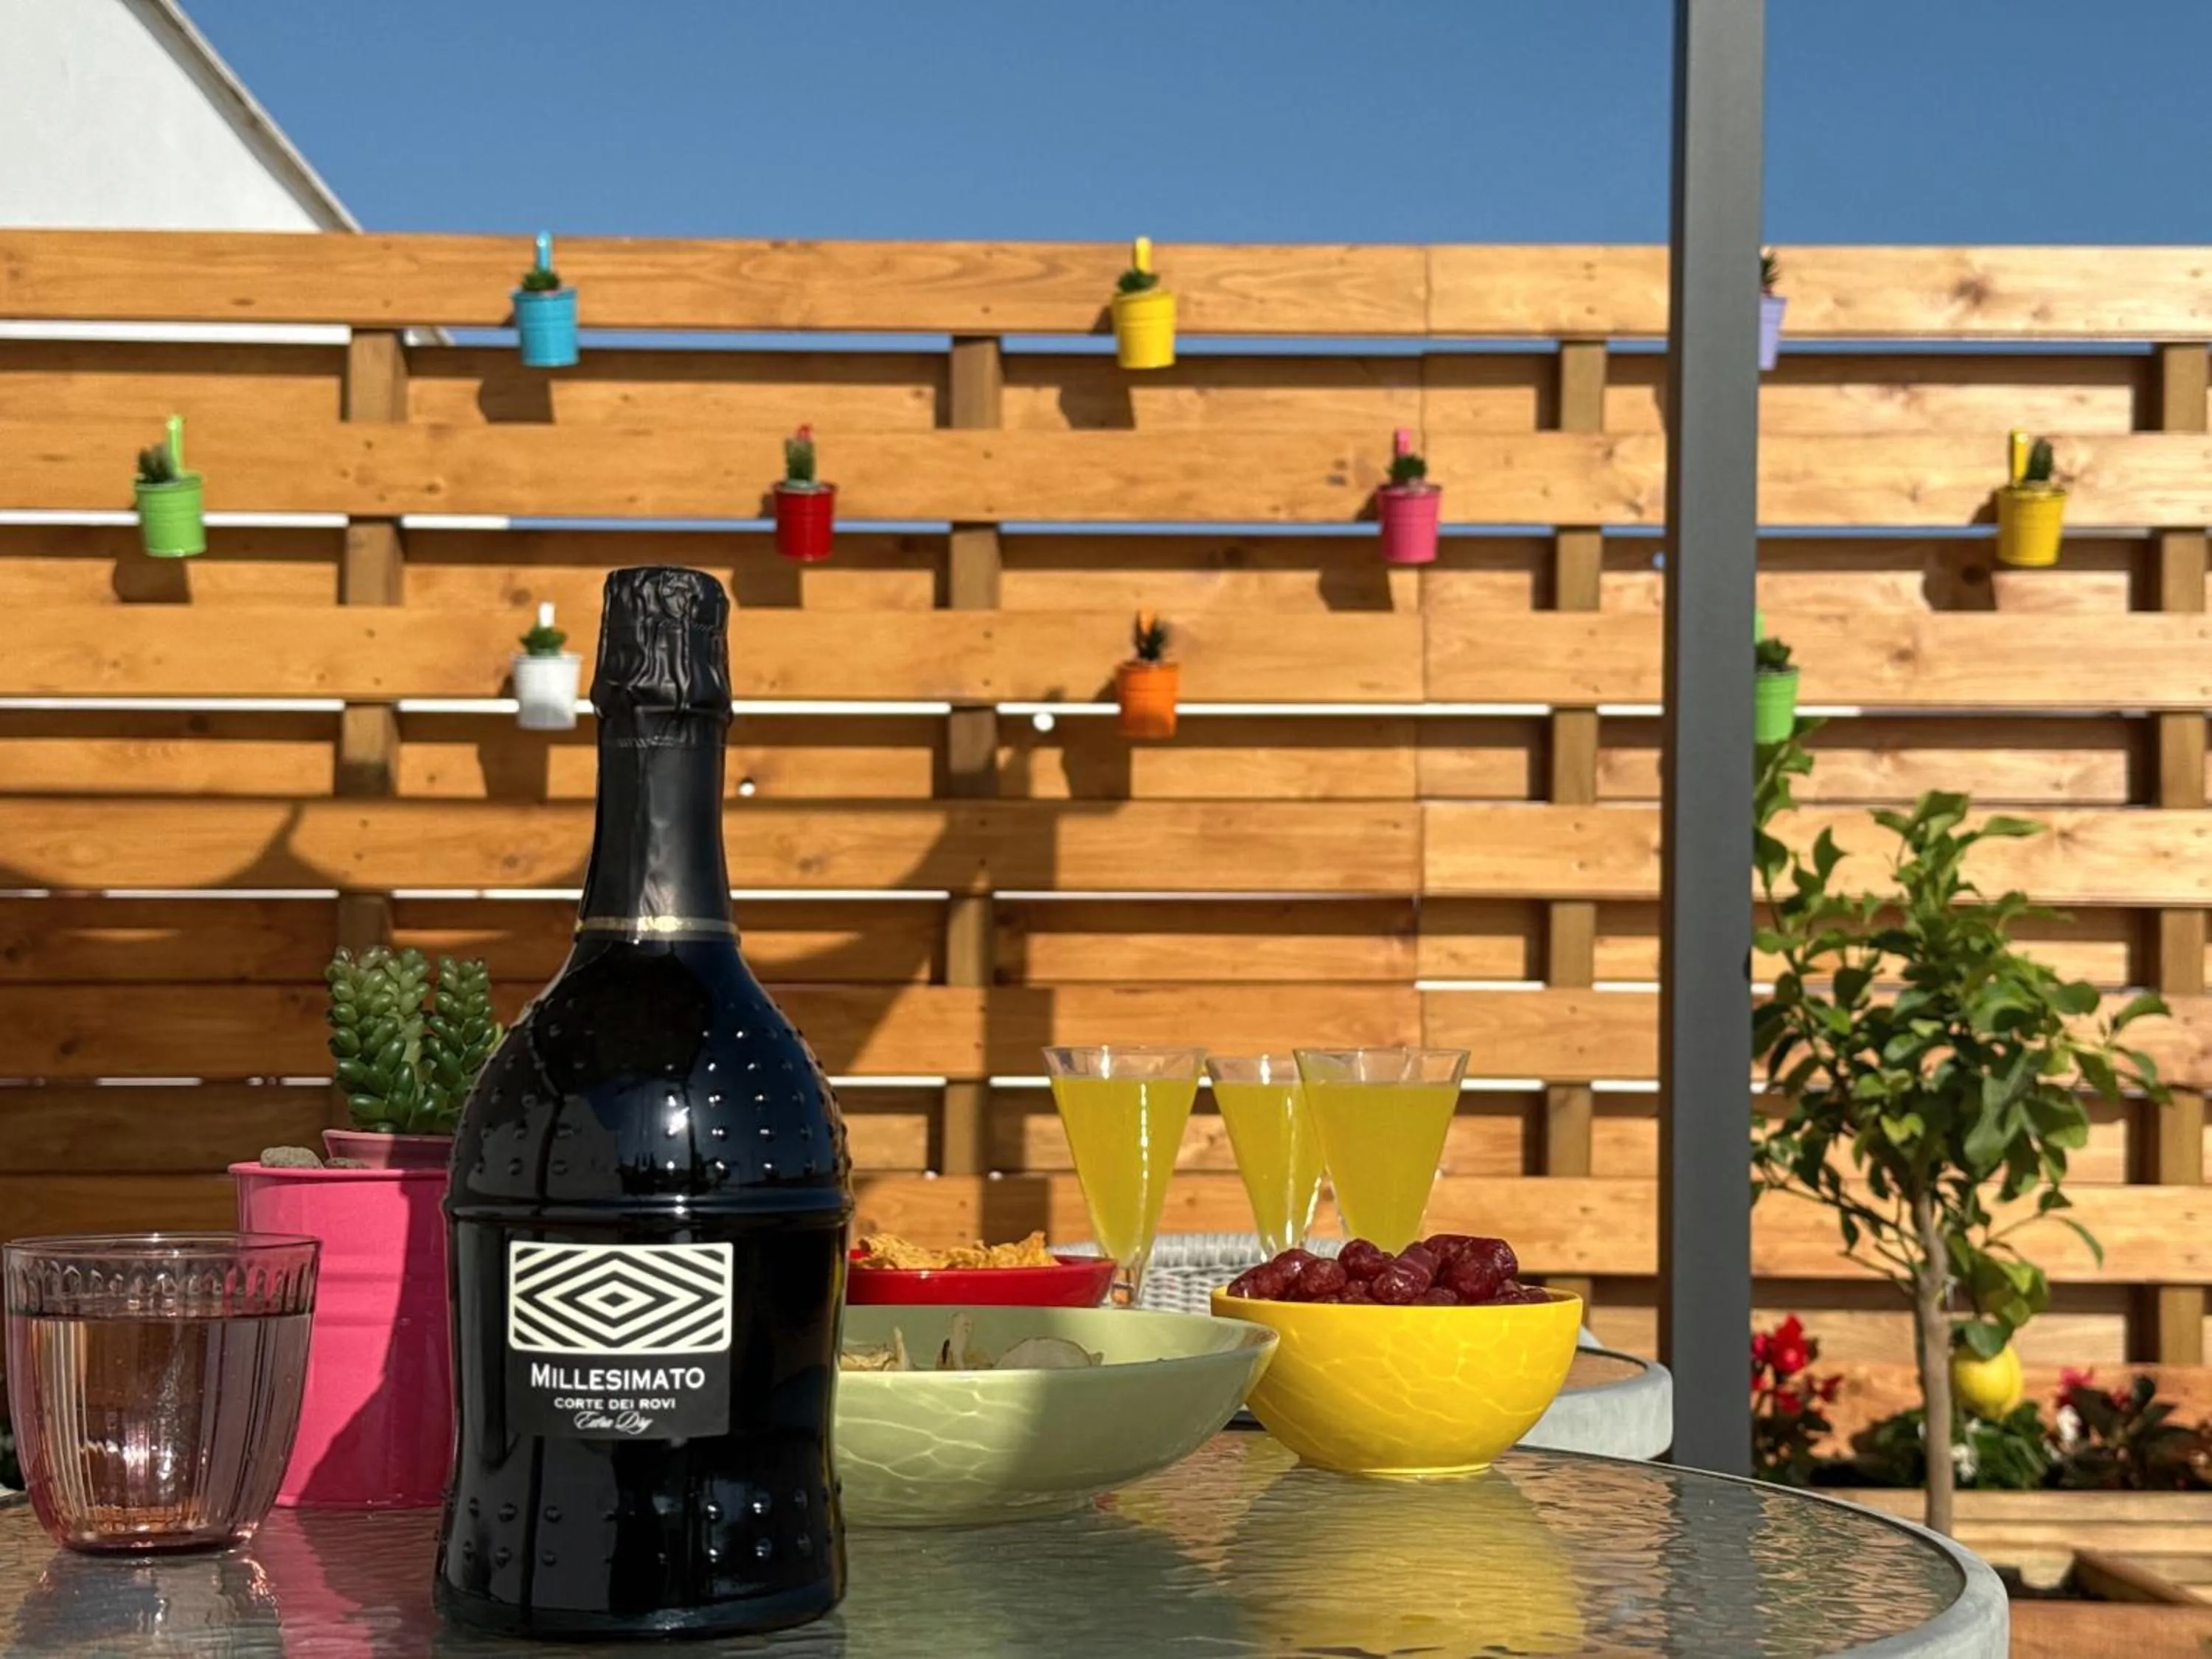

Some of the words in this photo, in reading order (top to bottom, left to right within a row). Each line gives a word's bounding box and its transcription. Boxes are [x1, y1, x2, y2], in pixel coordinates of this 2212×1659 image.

[530, 1362, 706, 1391] MILLESIMATO
[554, 1397, 604, 1409] CORTE
[608, 1398, 634, 1410] DEI
[639, 1397, 676, 1409] ROVI
